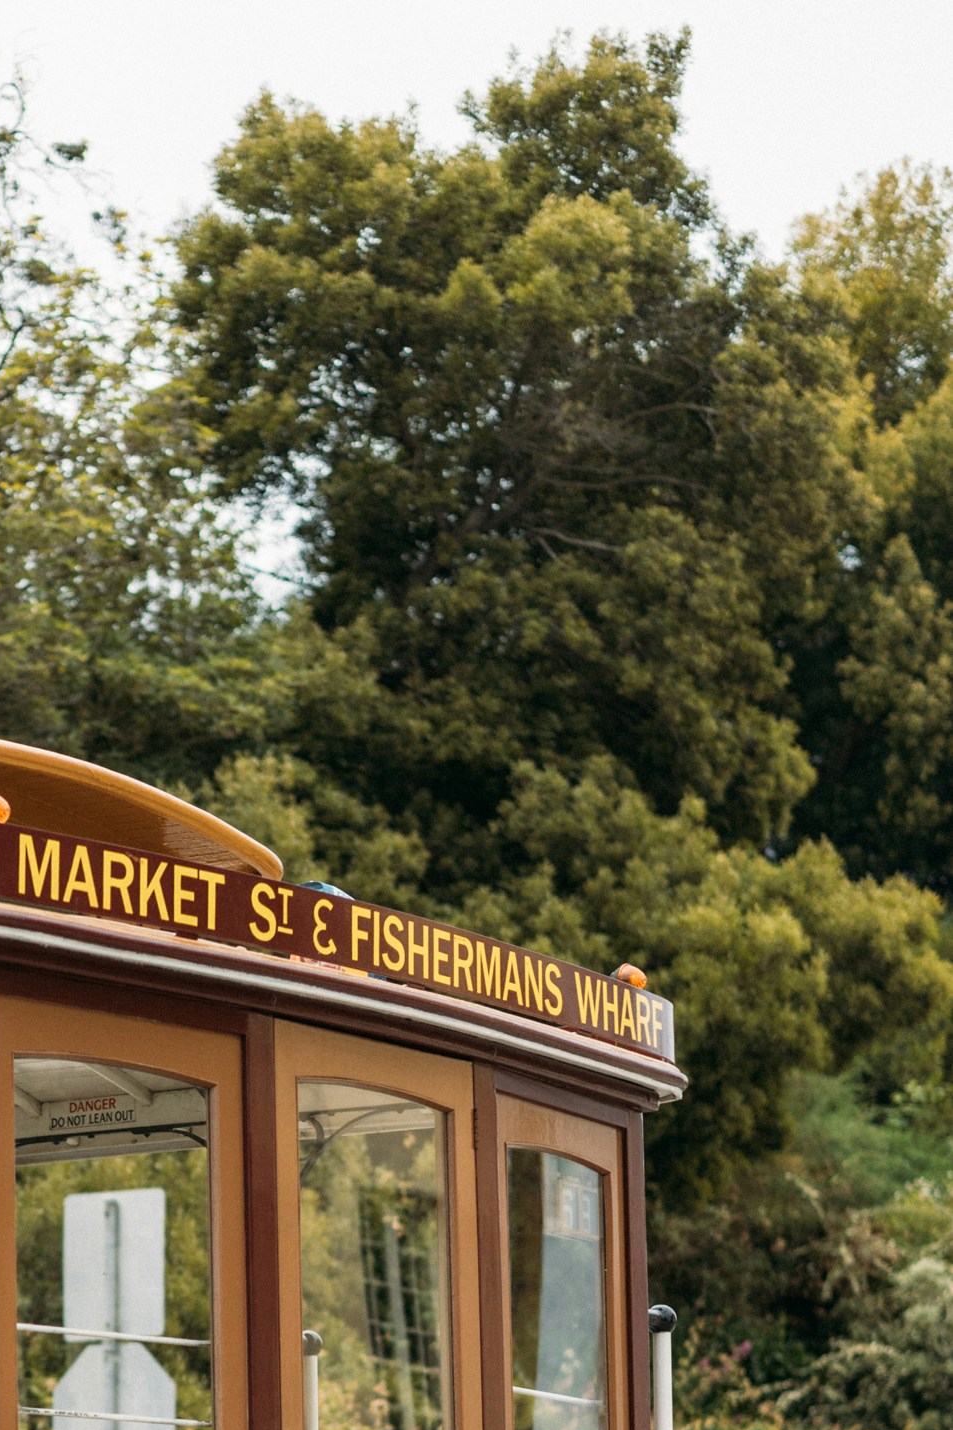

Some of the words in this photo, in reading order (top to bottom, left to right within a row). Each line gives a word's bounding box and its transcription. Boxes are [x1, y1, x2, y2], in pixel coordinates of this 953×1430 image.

[18, 833, 226, 931] MARKET
[312, 898, 338, 956] &
[351, 904, 564, 1017] FISHERMANS
[574, 970, 663, 1049] WHARF
[69, 1097, 116, 1113] DANGER
[51, 1117, 65, 1129] DO
[67, 1114, 86, 1127] NOT
[89, 1111, 113, 1124] LEAN
[114, 1109, 134, 1122] OUT
